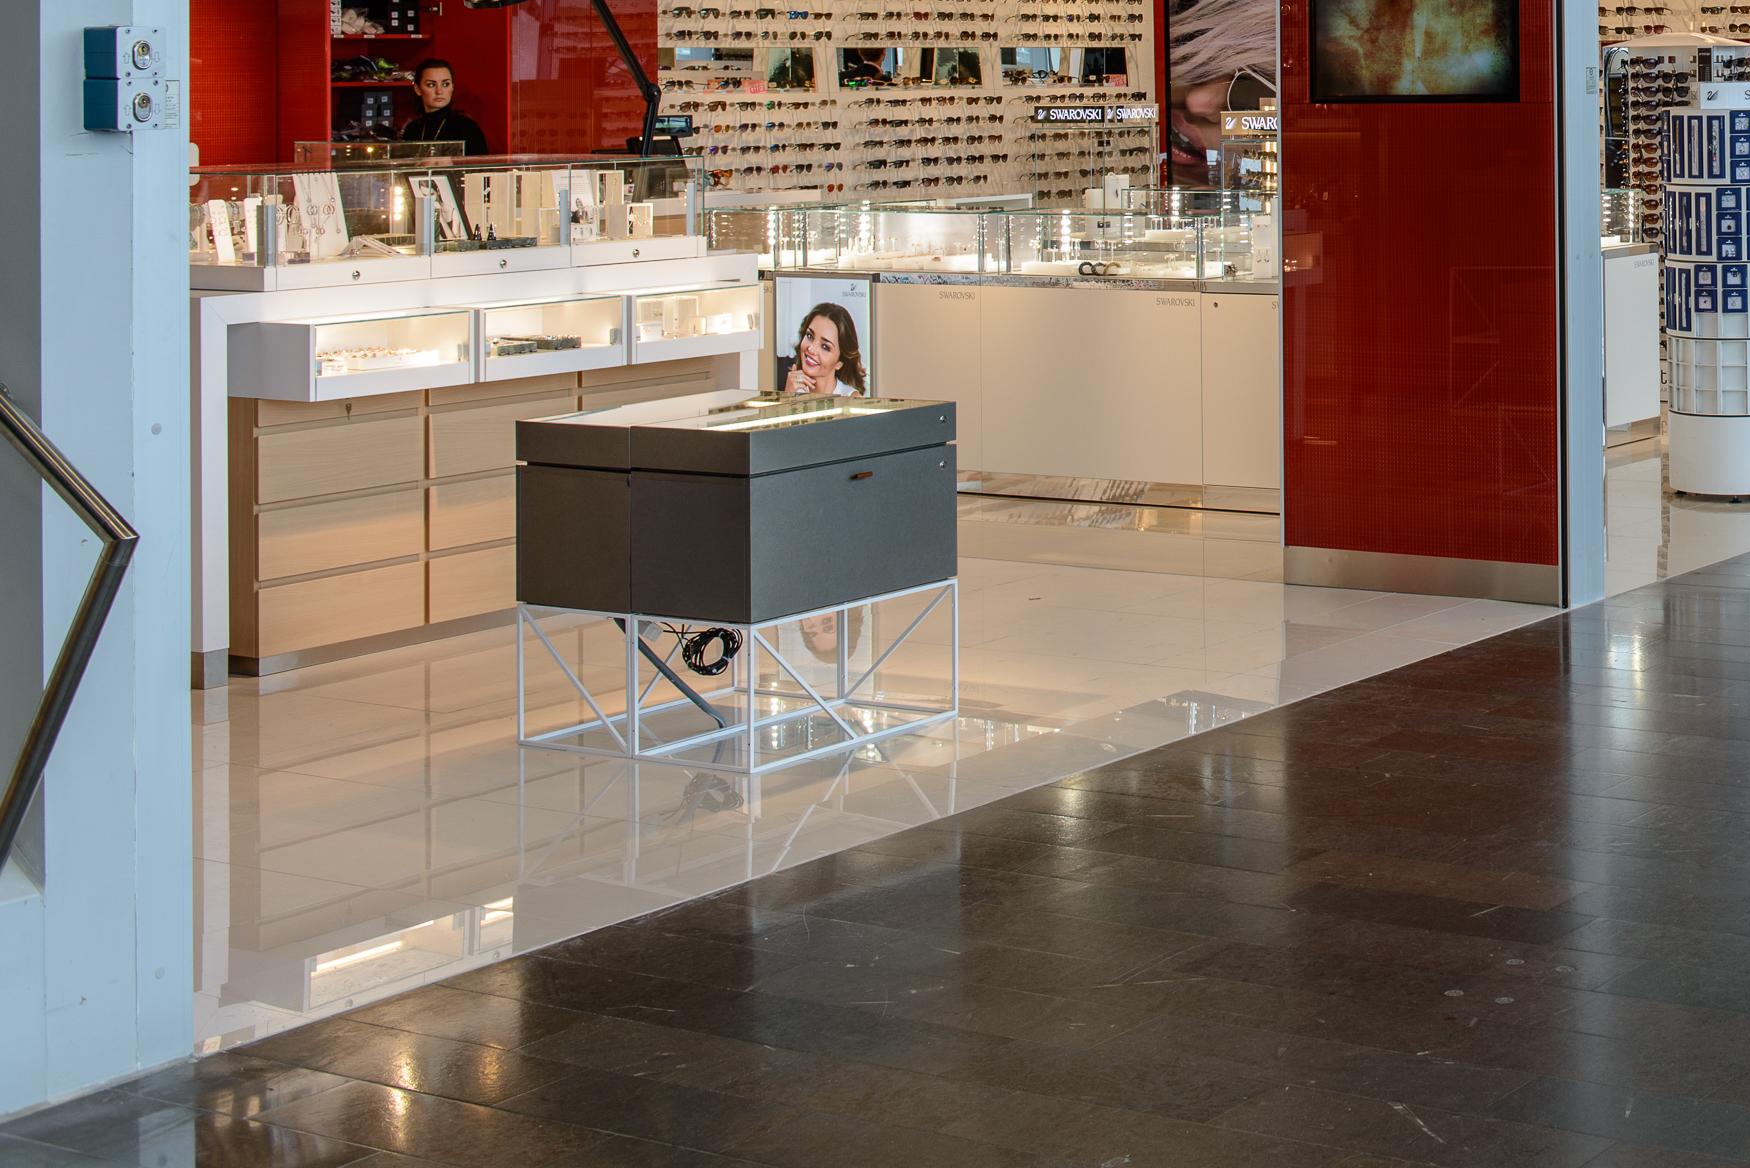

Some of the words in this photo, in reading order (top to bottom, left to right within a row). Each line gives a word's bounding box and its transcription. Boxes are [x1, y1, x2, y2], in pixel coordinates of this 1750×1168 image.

[1050, 108, 1102, 120] SWAROVSKI
[1116, 107, 1156, 120] SWAROVSKI
[1241, 116, 1277, 130] SWARO
[939, 291, 976, 300] SWAROVSKI
[1156, 298, 1196, 307] SWAROVSKI
